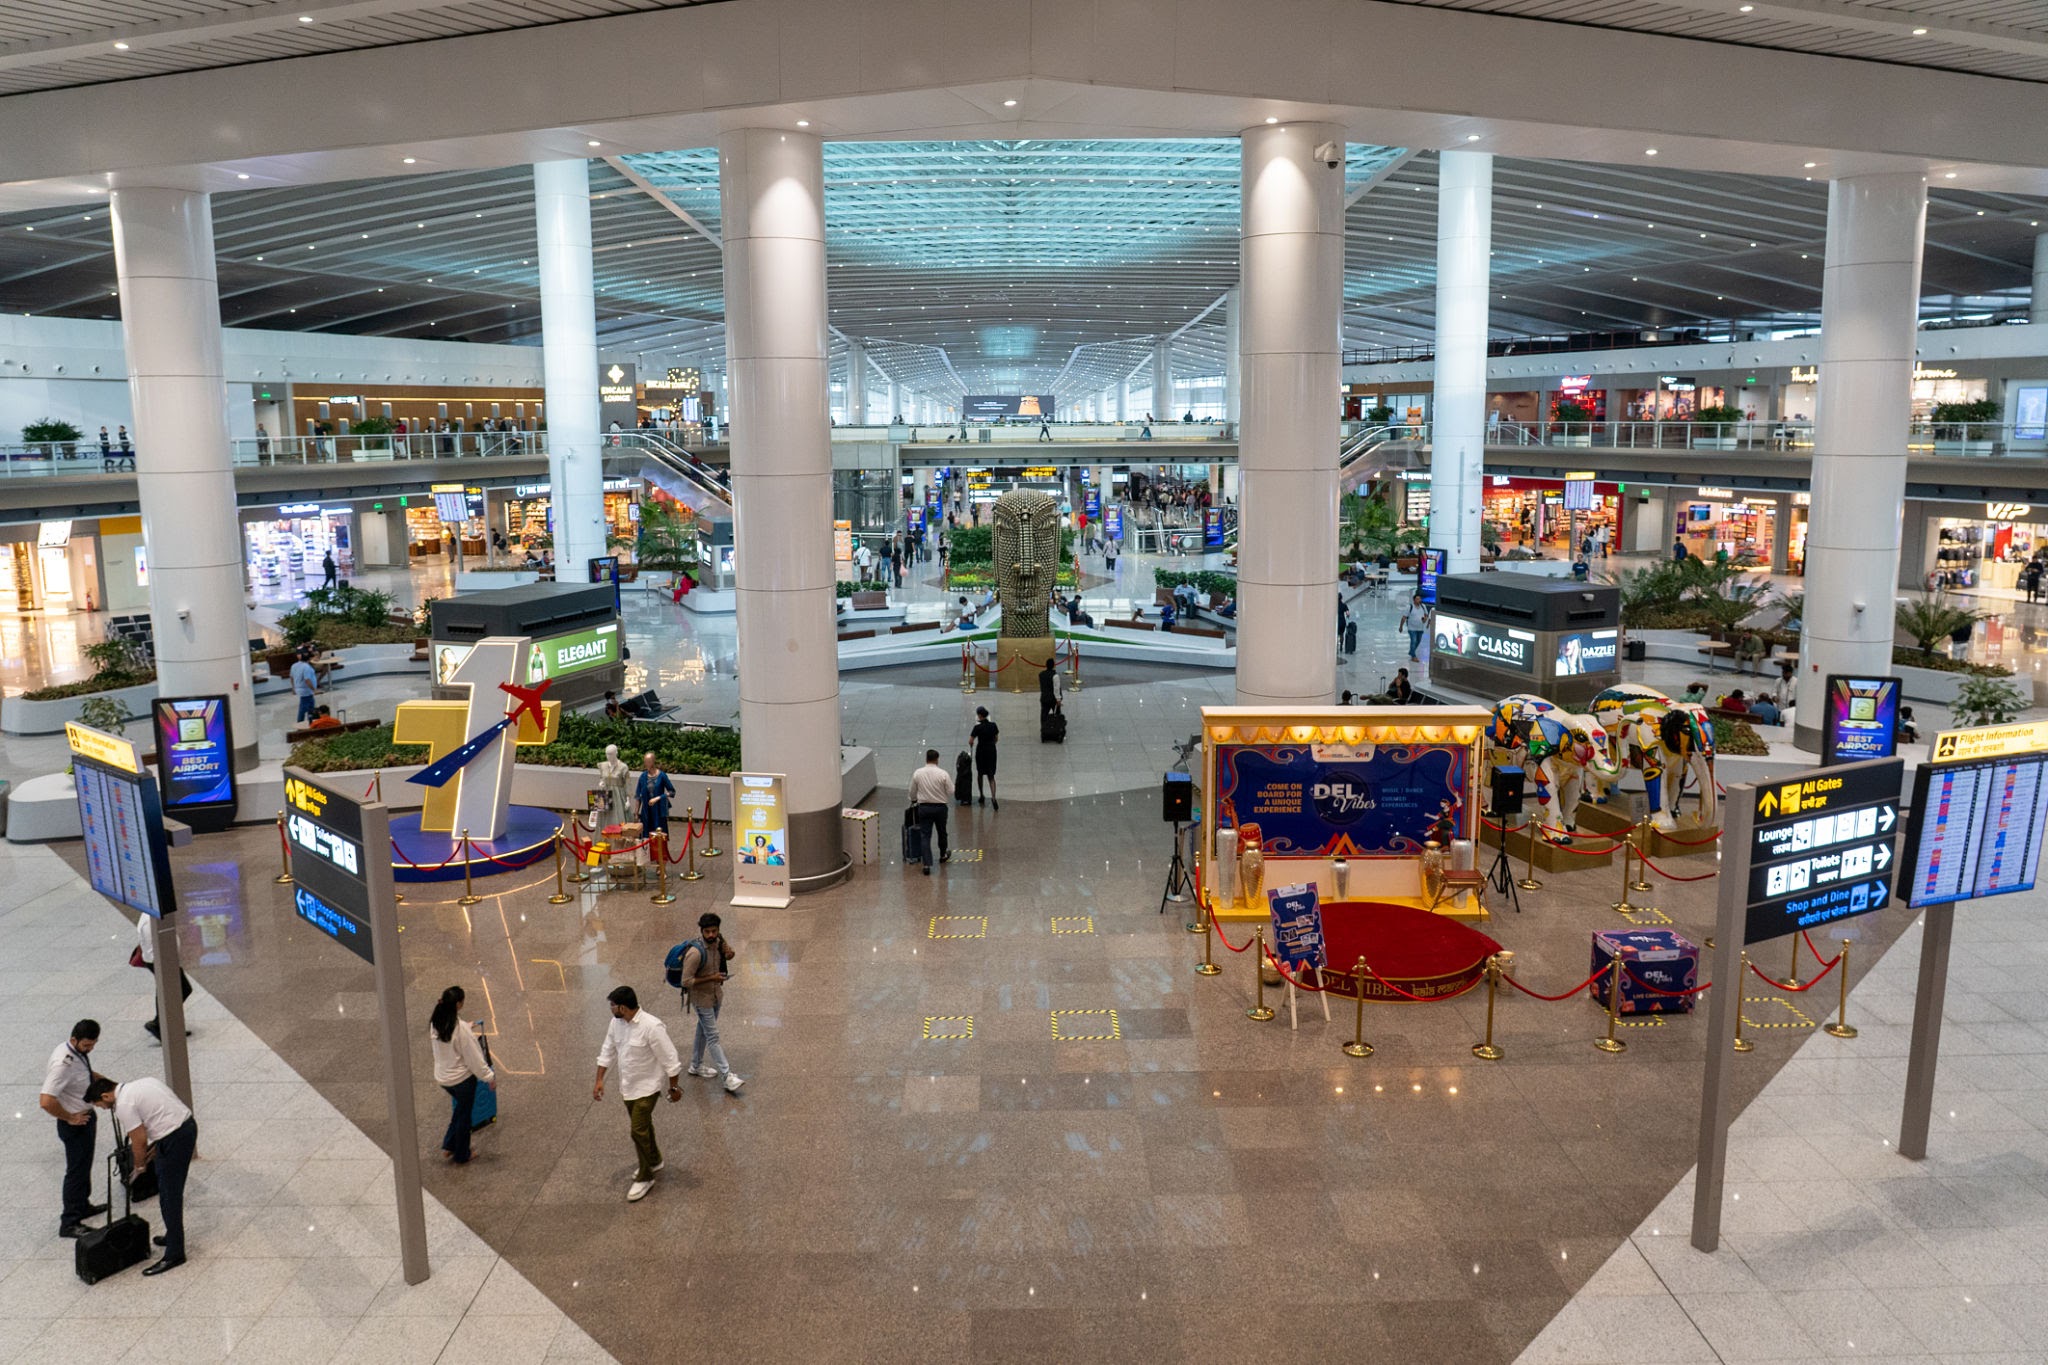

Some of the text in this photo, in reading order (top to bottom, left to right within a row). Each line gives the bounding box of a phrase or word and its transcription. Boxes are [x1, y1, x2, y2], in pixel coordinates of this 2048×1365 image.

[600, 386, 633, 394] ENCALM
[604, 394, 631, 402] LOUNGE
[1986, 502, 2031, 520] VIP
[558, 638, 608, 664] ELEGANT
[1478, 635, 1524, 659] CLASS!
[1582, 645, 1616, 657] DAZZLE!
[1847, 735, 1874, 743] BEST
[1959, 728, 2034, 745] Flight Information
[1836, 741, 1884, 752] AIRPORT
[172, 763, 220, 773] AIRPORT
[182, 756, 209, 765] BEST
[1313, 783, 1356, 800] DEL
[1802, 778, 1843, 794] All Gates
[1271, 799, 1302, 807] UNIQUE
[1333, 792, 1377, 814] Vibes
[1759, 826, 1793, 843] Lounge
[1811, 854, 1841, 870] Toilets
[1786, 889, 1850, 914] Shop and Dine
[315, 899, 342, 928] Shopping
[342, 915, 357, 934] Area
[1645, 970, 1664, 979] DEL
